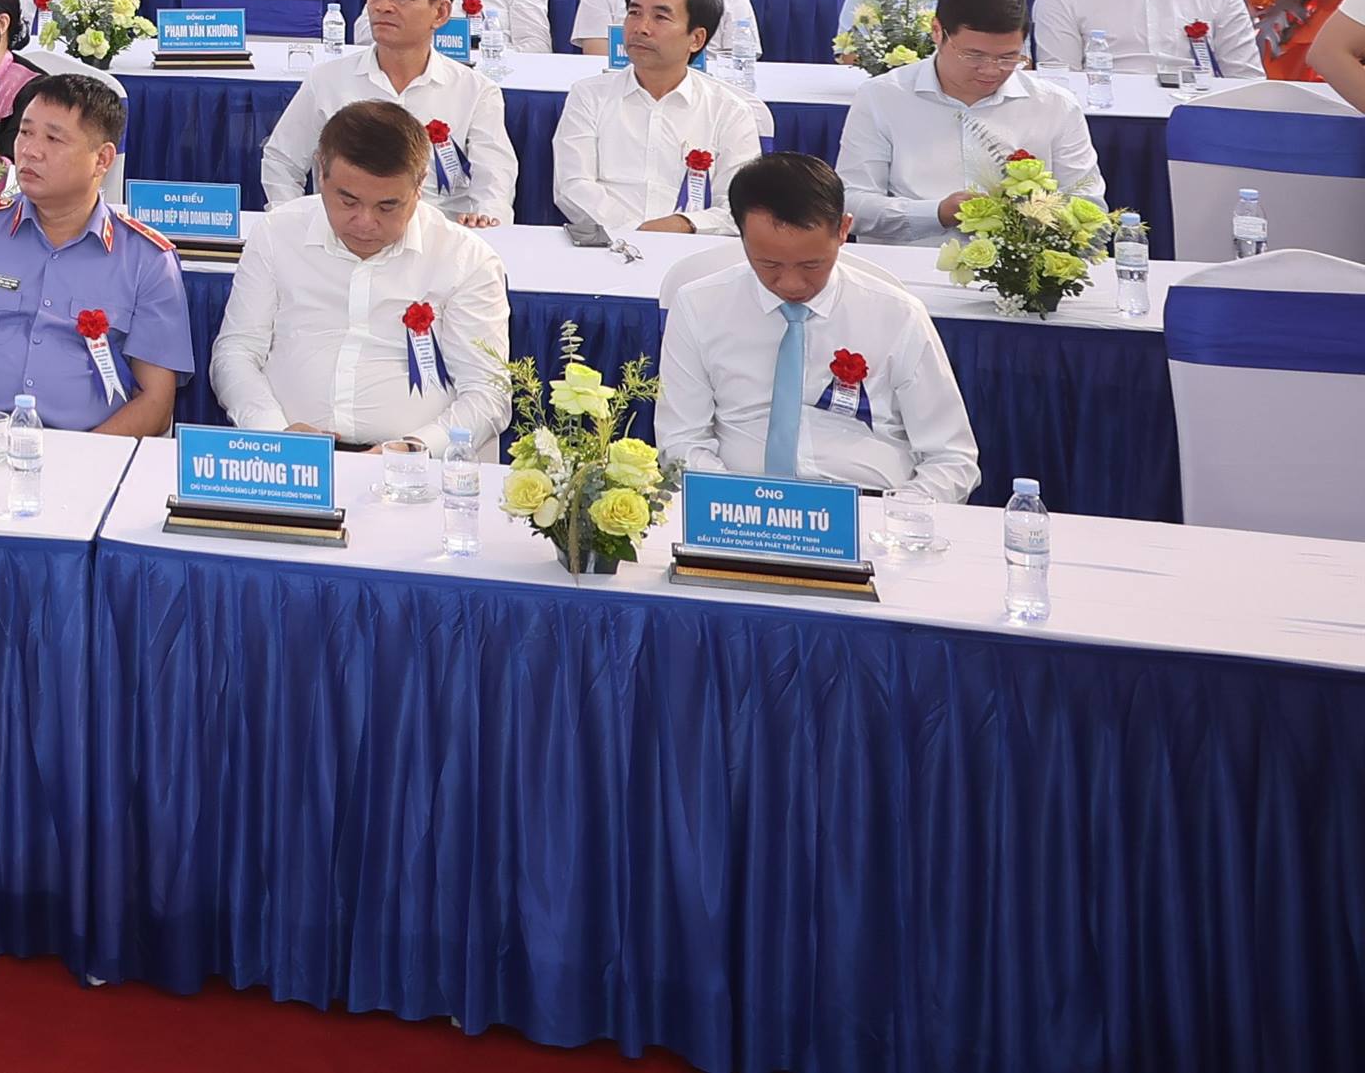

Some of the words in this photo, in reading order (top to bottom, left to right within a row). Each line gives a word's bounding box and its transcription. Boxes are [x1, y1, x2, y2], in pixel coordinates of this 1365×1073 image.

[164, 24, 187, 40] PHẠM
[188, 23, 205, 38] VĂN
[436, 34, 463, 48] PHONG
[164, 193, 180, 204] ĐẠI
[182, 191, 204, 203] BIỂU
[190, 210, 211, 226] DOANH
[228, 438, 260, 451] ĐỒNG
[262, 441, 281, 453] CHÍ
[193, 453, 215, 479] VŨ
[219, 456, 287, 485] TRƯỜNG
[291, 464, 319, 488] THI
[755, 486, 784, 500] ÔNG
[710, 502, 761, 527] PHẠM
[766, 506, 803, 529] ANH
[807, 508, 830, 532] TÚ
[720, 527, 738, 536] TỔNG
[739, 529, 756, 538] GIÁM
[757, 530, 771, 539] ĐỐC
[772, 532, 792, 541] CÔNG
[735, 538, 755, 547] DỰNG
